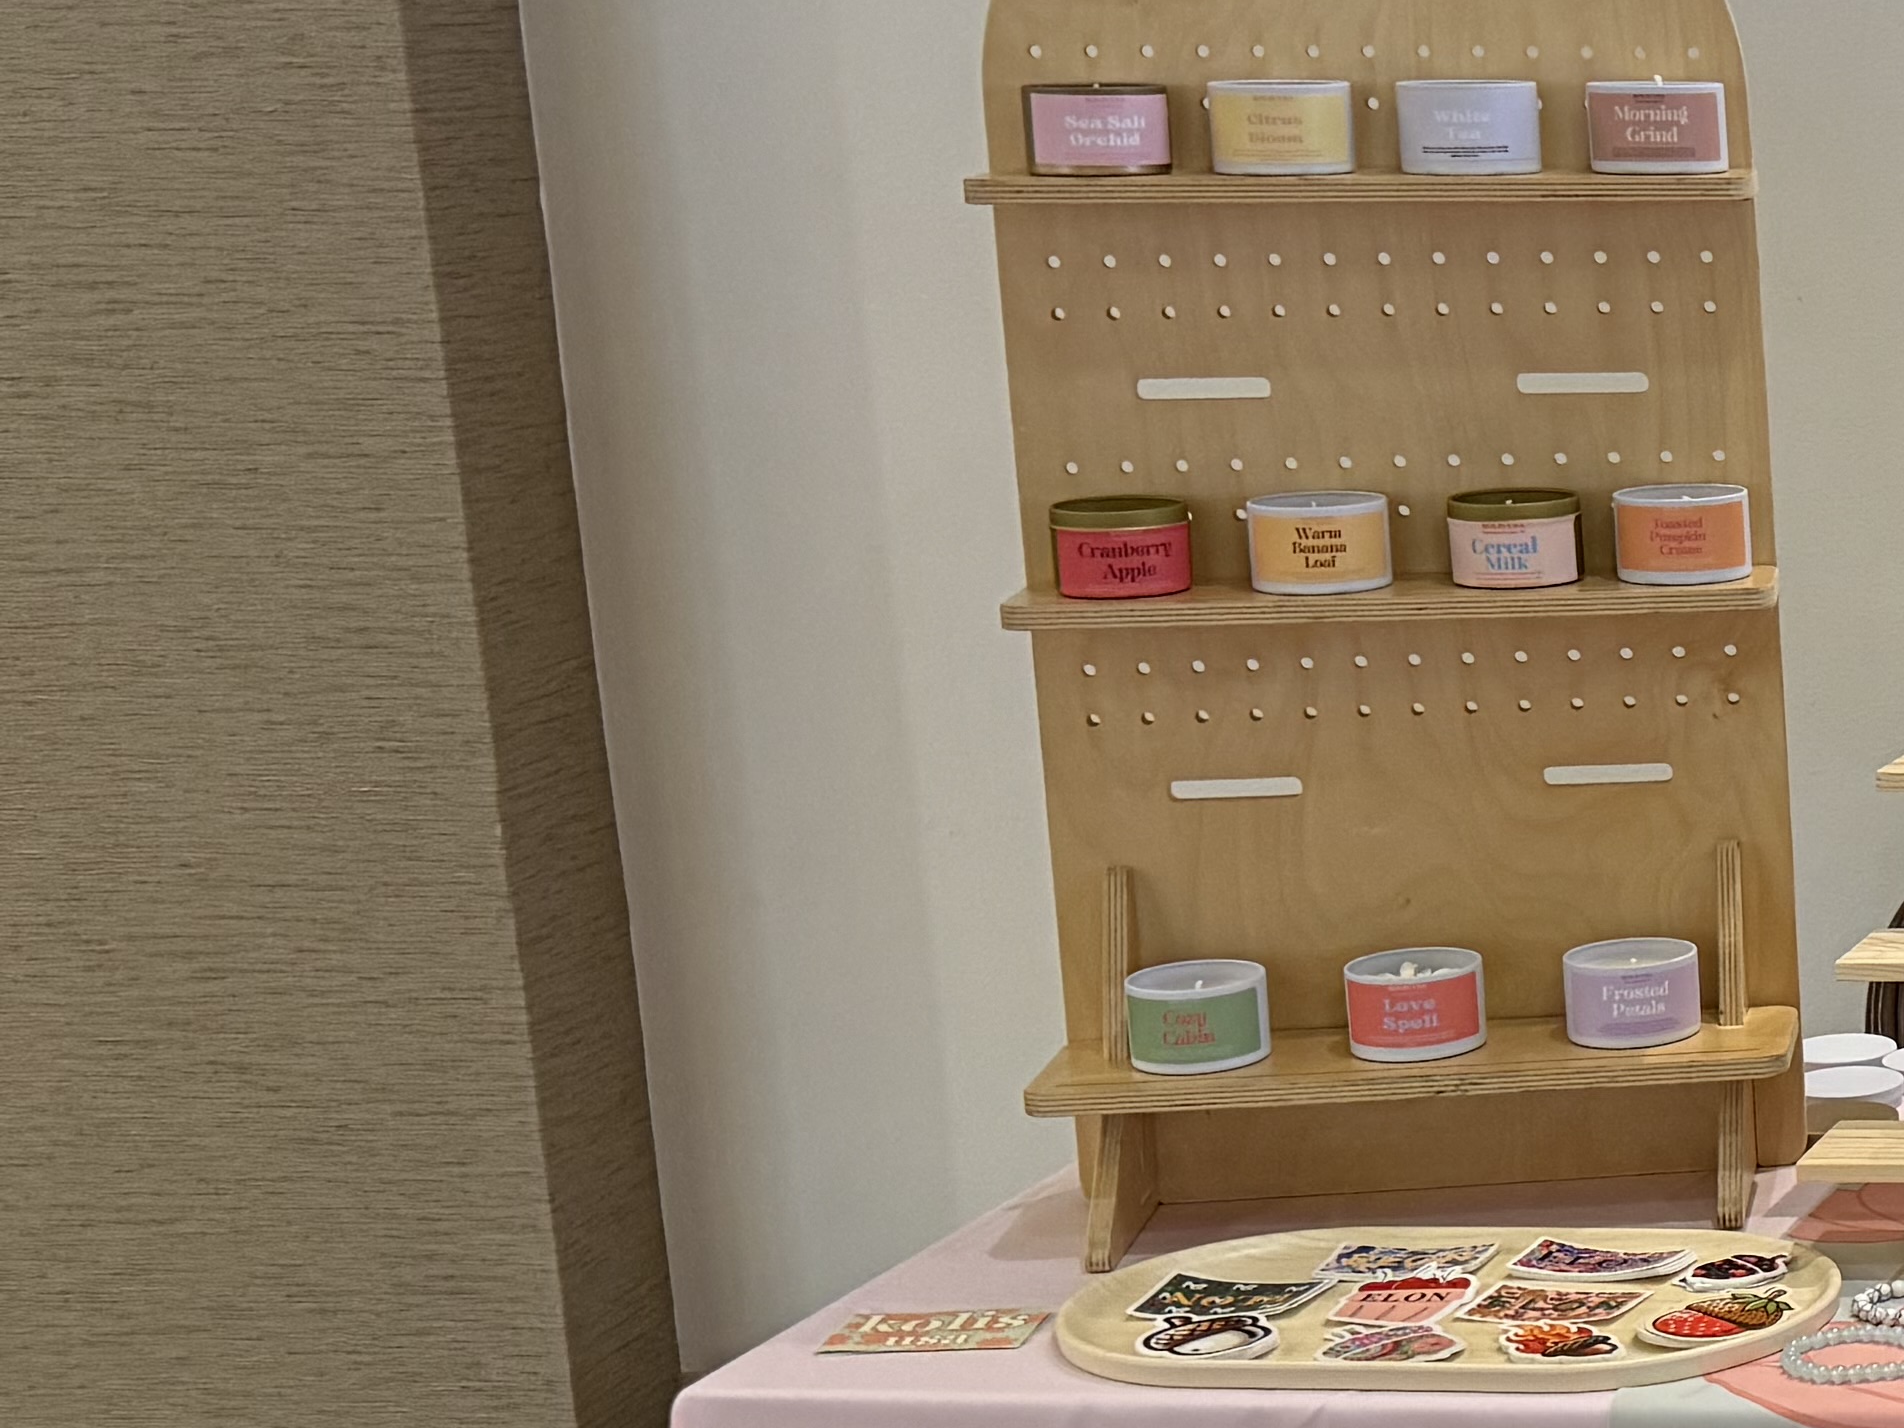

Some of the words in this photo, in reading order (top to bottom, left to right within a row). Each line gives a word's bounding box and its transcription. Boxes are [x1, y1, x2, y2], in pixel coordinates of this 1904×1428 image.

[1064, 114, 1103, 130] Sea
[1105, 113, 1147, 130] Salt
[1612, 105, 1689, 124] Morning
[1068, 131, 1142, 148] Orchid
[1624, 124, 1678, 145] Grind
[1293, 526, 1343, 541] Warm
[1076, 538, 1173, 558] Cranberry
[1291, 540, 1348, 555] Banana
[1471, 535, 1540, 556] Cereal
[1102, 560, 1158, 583] Apple
[1304, 555, 1337, 570] Loaf
[1484, 553, 1530, 572] Milk
[1602, 980, 1669, 1001] Frosted
[1383, 997, 1437, 1014] Love
[1612, 999, 1667, 1019] Petals
[1161, 1009, 1208, 1029] Cozy
[1382, 1013, 1439, 1033] Spell
[1360, 1290, 1453, 1304] ELON
[858, 1310, 1030, 1333] kolis
